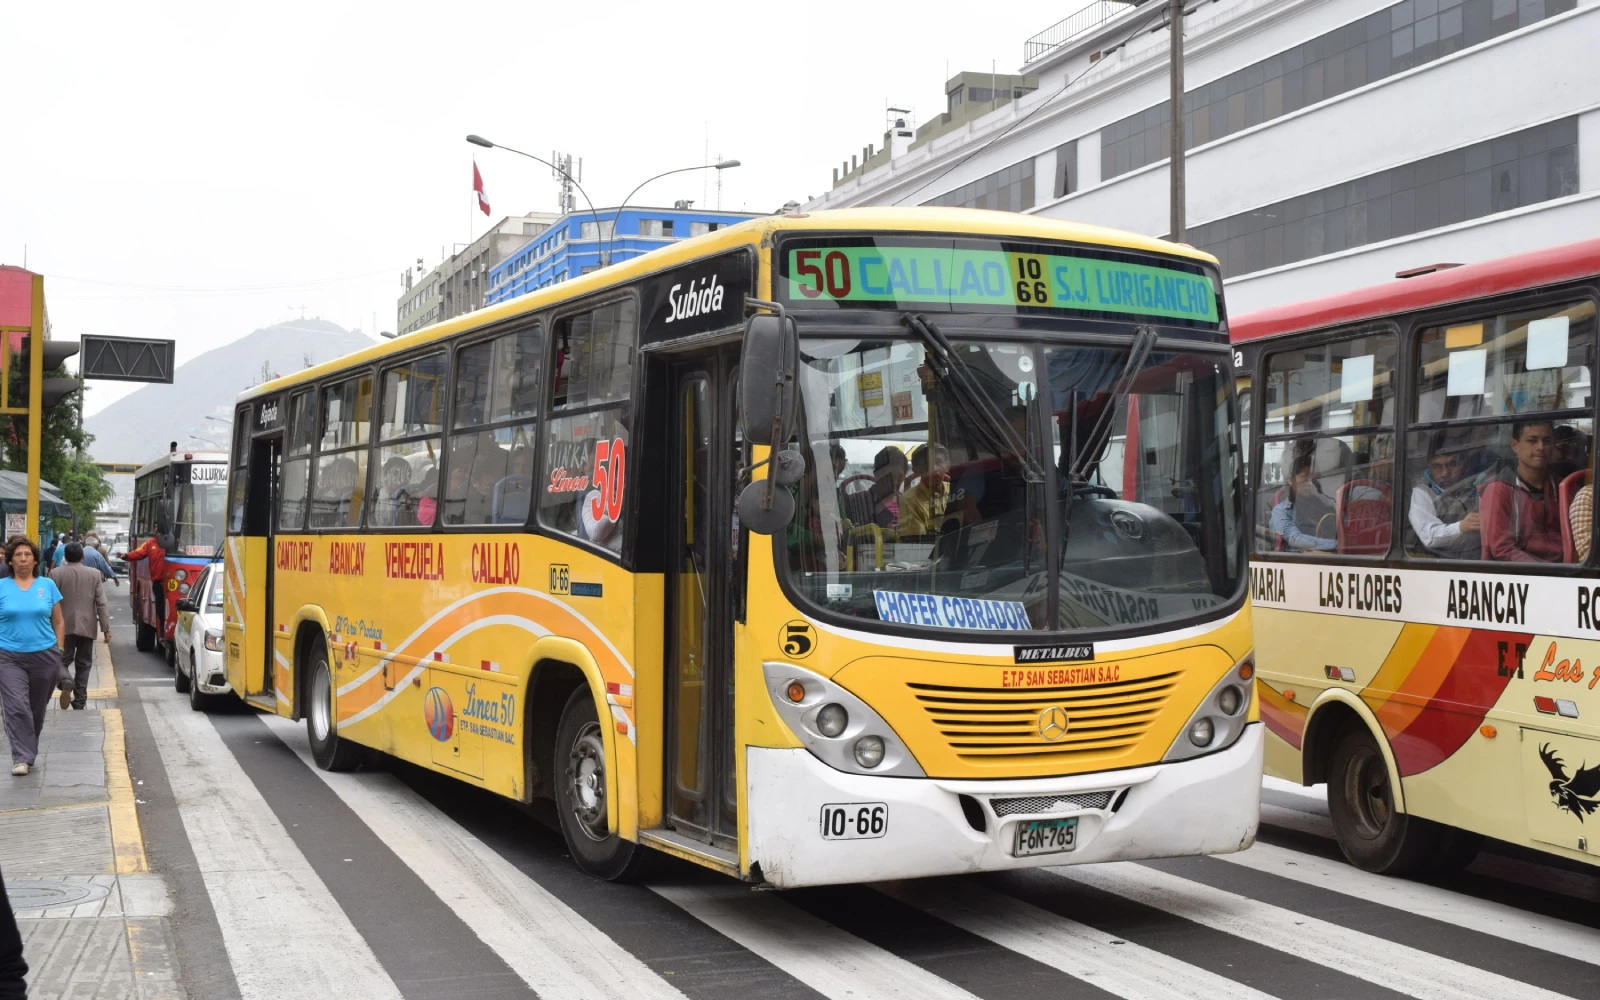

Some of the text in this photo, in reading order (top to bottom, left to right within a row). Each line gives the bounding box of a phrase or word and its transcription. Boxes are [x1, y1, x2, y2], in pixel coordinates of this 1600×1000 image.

[796, 250, 1006, 299] 50 CALLAO
[1017, 257, 1042, 280] 10
[665, 274, 725, 324] Subida
[1016, 281, 1048, 304] 66
[1055, 265, 1210, 316] S.J. LURIGANCHO
[260, 400, 278, 429] Bajada
[591, 437, 626, 524] 50
[276, 541, 520, 585] CANTO REY ABANCAY VENEZUELA CALLAO
[550, 567, 569, 591] 10-66
[875, 590, 1033, 630] CHOFER COBRADOR
[1249, 566, 1286, 602] MARIA
[1319, 571, 1344, 609] LAS
[1348, 573, 1402, 614] FLORES
[1446, 579, 1530, 625] ABANCAY
[784, 623, 811, 656] 5
[1018, 646, 1092, 660] METALBUS
[1002, 664, 1120, 688] E.T.P SAN SEBASTIAN S.A.C
[1533, 640, 1585, 684] Las
[462, 680, 515, 727] Linea 50
[470, 722, 479, 735] SAN
[479, 724, 505, 742] SEBASTIAN
[823, 806, 884, 837] 10-66
[1019, 825, 1074, 851] F6N-765
